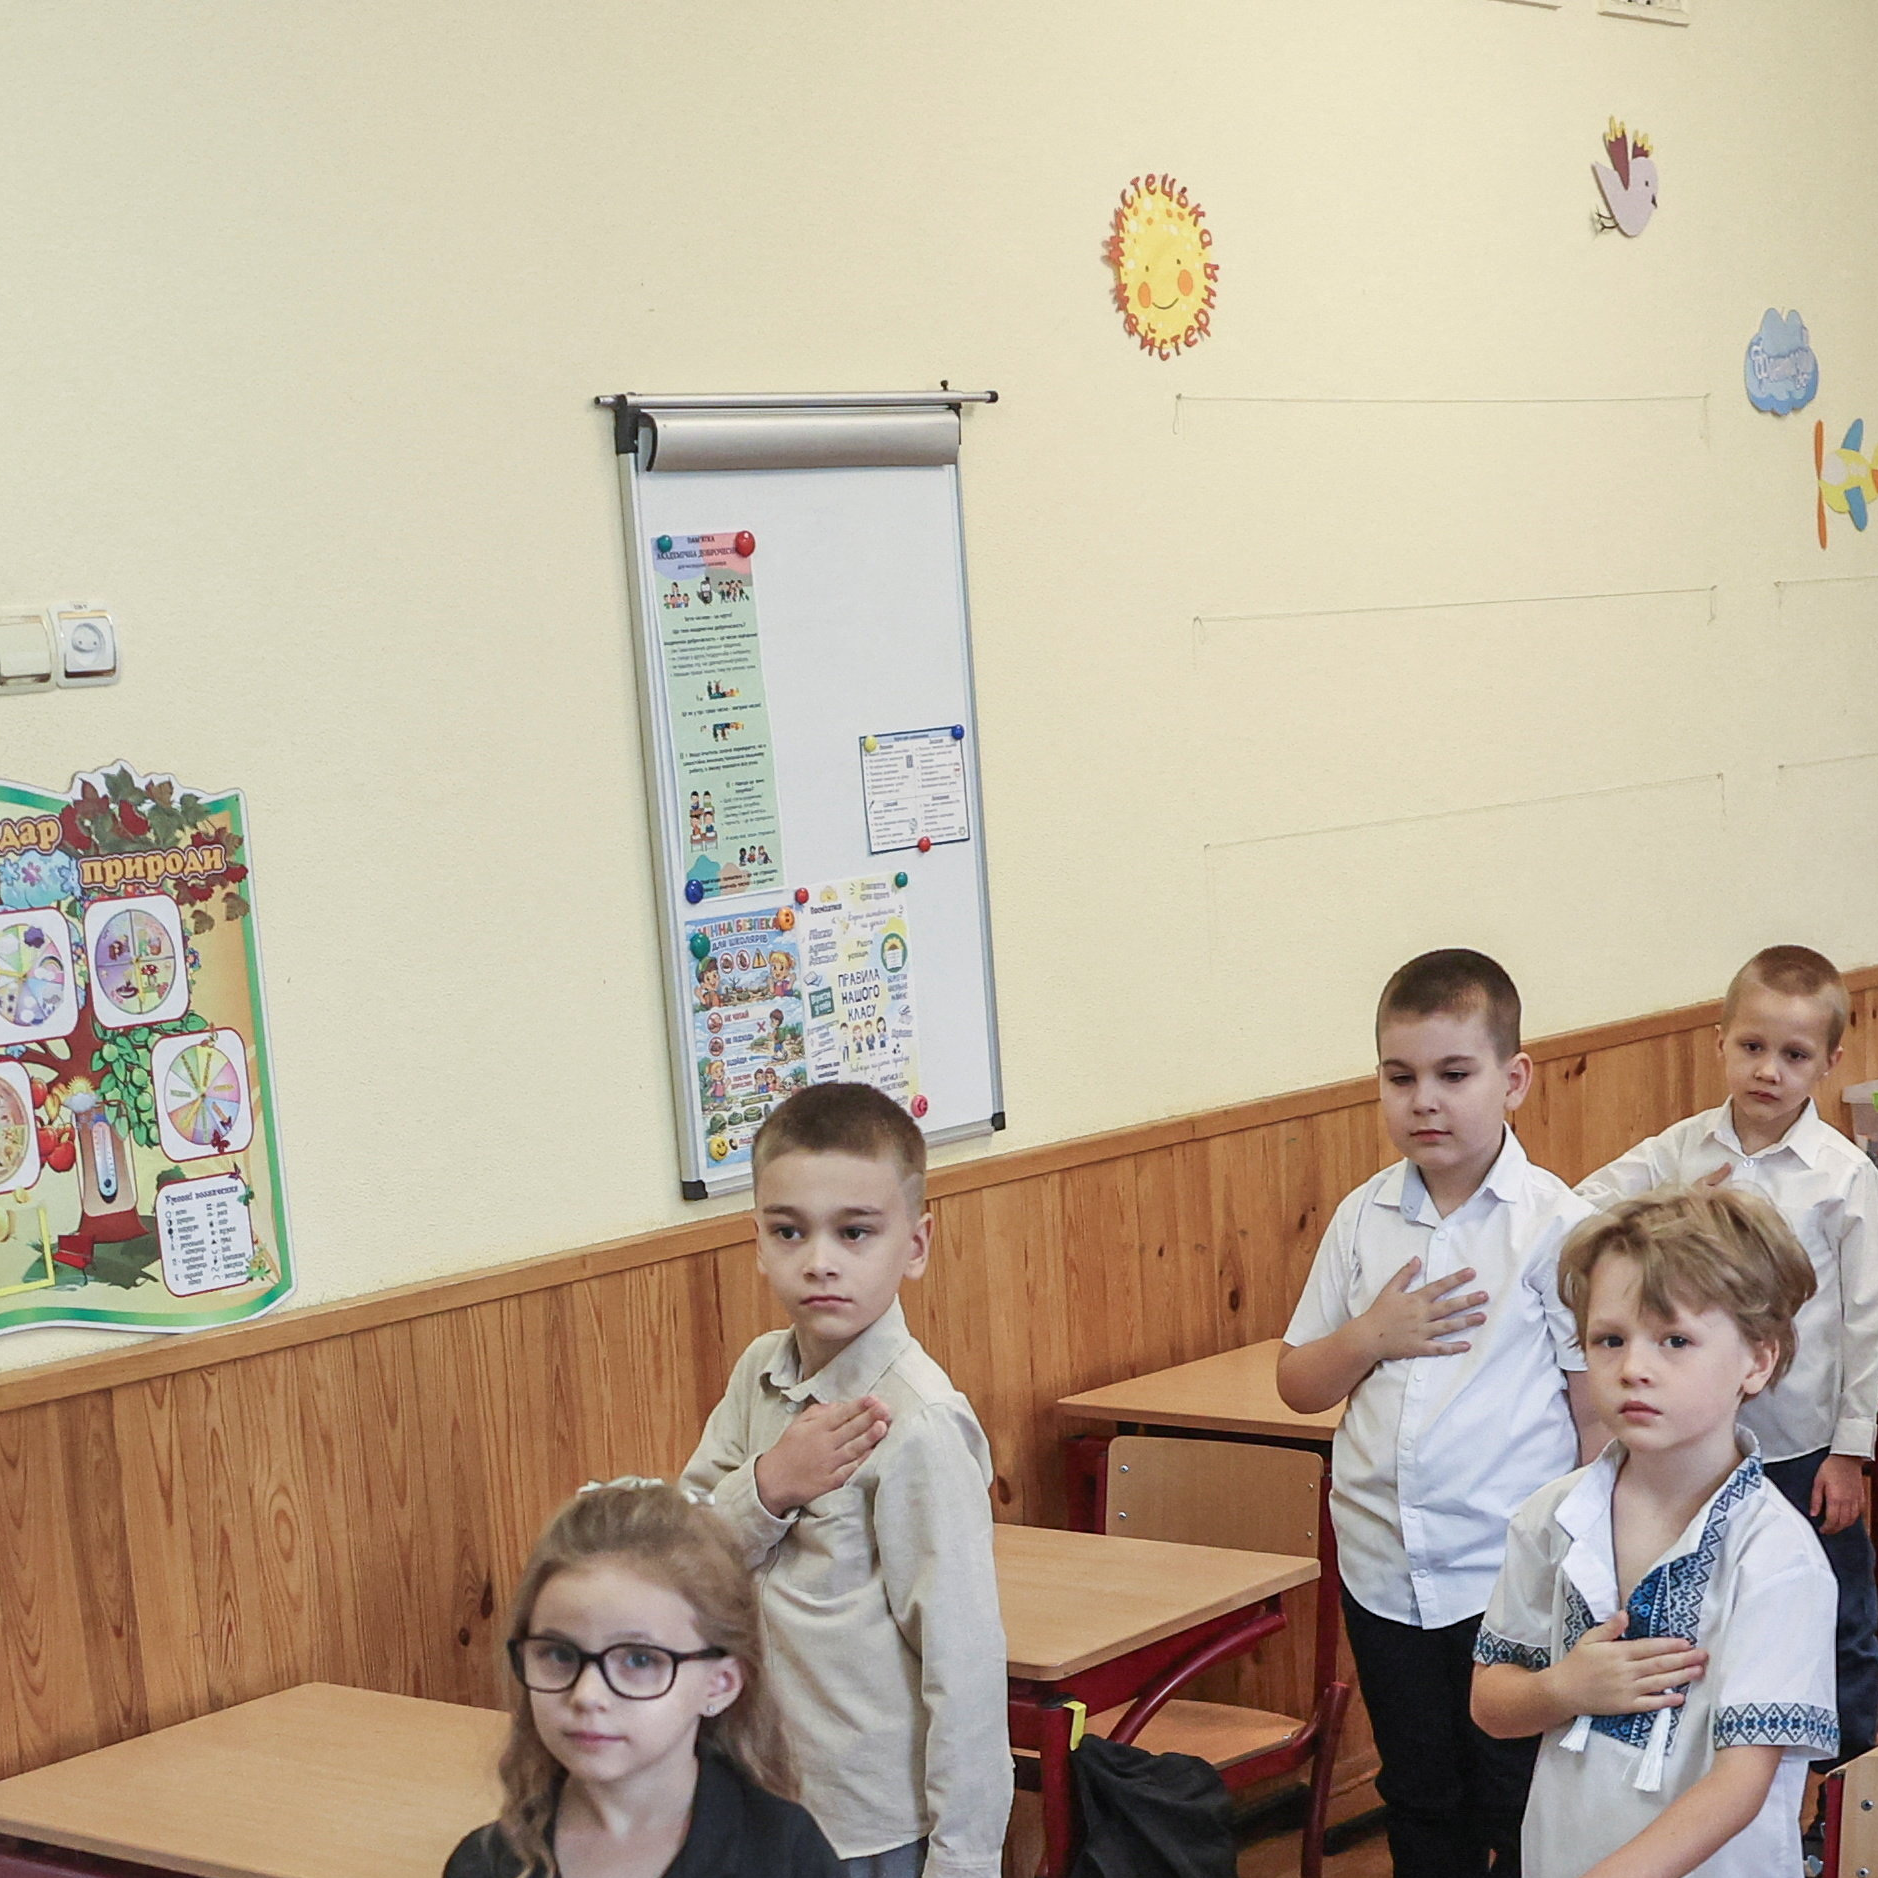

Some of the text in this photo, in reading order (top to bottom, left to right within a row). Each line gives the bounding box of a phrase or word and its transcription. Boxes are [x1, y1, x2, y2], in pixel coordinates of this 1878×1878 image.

[80, 848, 225, 889] природи
[838, 968, 880, 987] ПРАВИЛА
[841, 985, 880, 1005] НАШОГО
[848, 1004, 876, 1021] КЛАСУ
